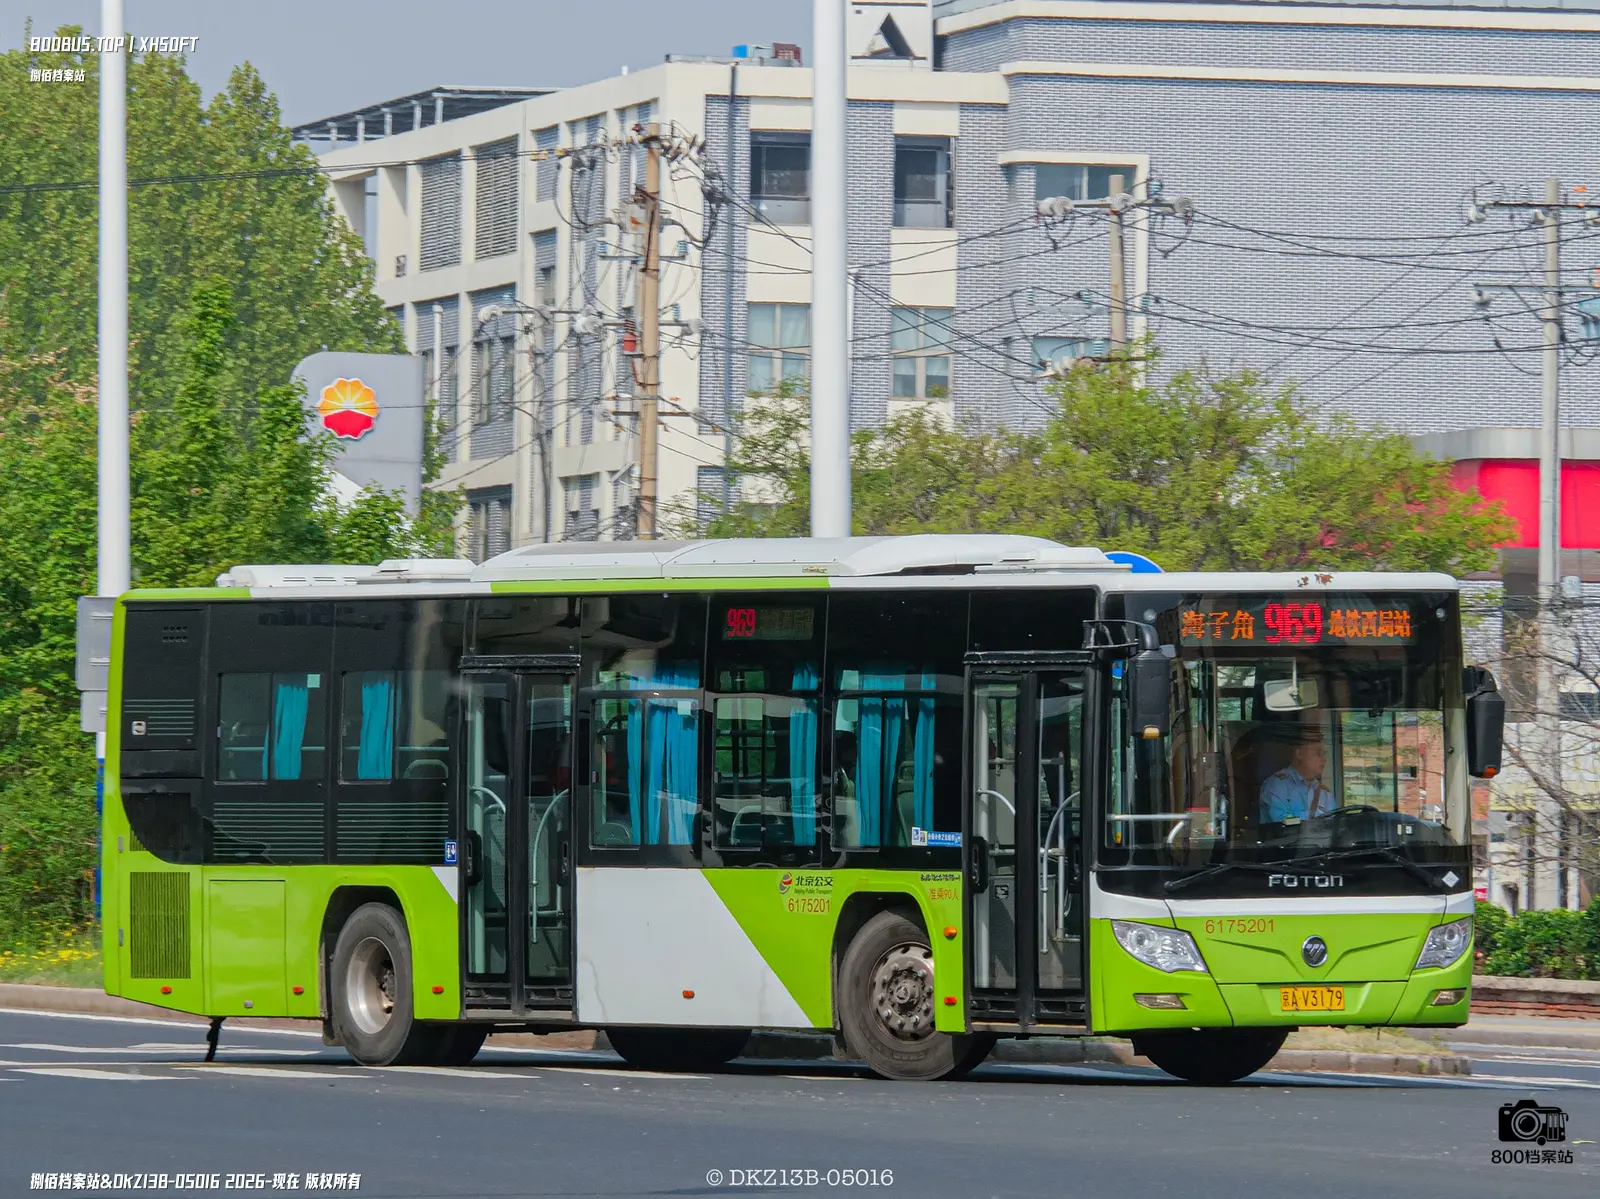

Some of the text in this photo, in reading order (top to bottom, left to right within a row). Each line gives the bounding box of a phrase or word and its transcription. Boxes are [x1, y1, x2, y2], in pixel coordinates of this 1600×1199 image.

[727, 608, 756, 637] 969
[1181, 603, 1411, 644] 海子角 969 地铁西局站
[796, 876, 834, 887] 北京公交
[788, 898, 830, 912] 6175201
[1205, 919, 1275, 934] 6175201
